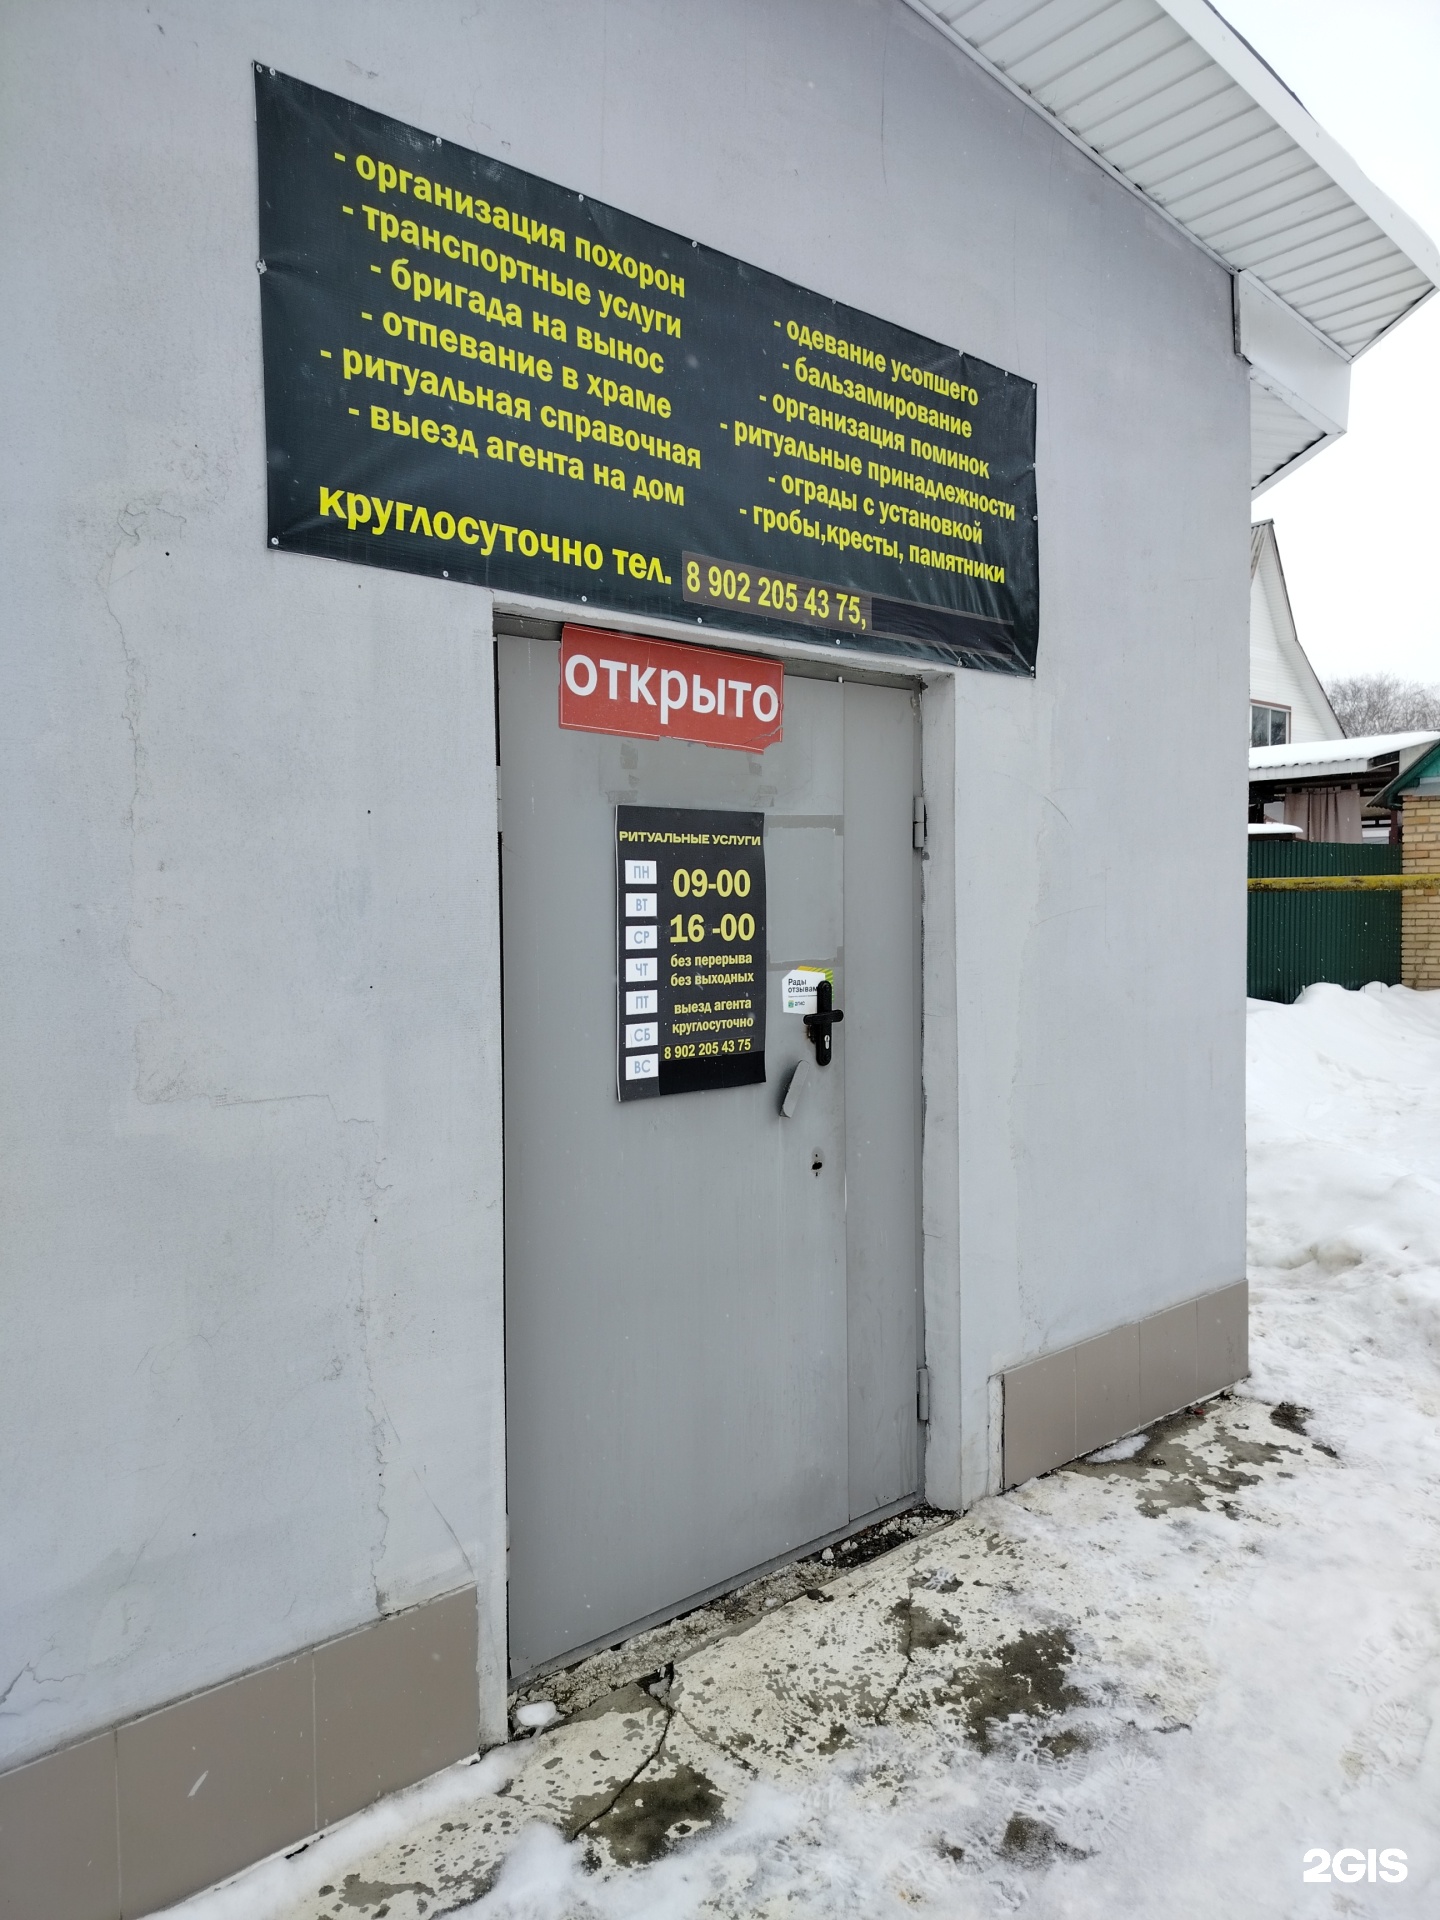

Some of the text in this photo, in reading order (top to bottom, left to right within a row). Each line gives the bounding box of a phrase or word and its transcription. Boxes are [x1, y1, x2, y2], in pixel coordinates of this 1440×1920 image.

[355, 154, 566, 253] организация
[575, 236, 685, 298] похорон
[361, 205, 592, 306] транспортные
[598, 289, 682, 339] услуги
[390, 257, 523, 328] бригада
[533, 311, 567, 343] на
[576, 325, 665, 375] вынос
[382, 311, 554, 383] отпевание
[562, 366, 580, 391] в
[586, 374, 672, 419] храме
[786, 319, 887, 373] одевание
[891, 358, 979, 407] усопшего
[343, 347, 532, 421] ритуальная
[540, 405, 702, 470] справочная
[795, 357, 973, 438] бальзамирование
[772, 393, 906, 452] организация
[911, 438, 990, 479] поминок
[370, 405, 480, 458] выезд
[487, 435, 585, 481] агента
[593, 464, 626, 491] на
[633, 475, 685, 507] дом
[734, 421, 863, 476] ритуальные
[868, 461, 1016, 521] принадлежности
[781, 474, 858, 512] ограды
[863, 496, 875, 516] с
[879, 498, 983, 545] установкой
[320, 486, 867, 630] круглосуточно тел. 8 902 205 43 75,
[909, 545, 1005, 584] памятники
[619, 831, 761, 846] РИТУАЛЬНЫЕ УСЛУГИ
[633, 865, 650, 879] ПН
[672, 868, 751, 898] 09-00
[635, 898, 648, 912] ВТ
[633, 930, 650, 945] СР
[635, 963, 648, 977] ЧТ
[670, 952, 753, 969] без перерыва
[670, 972, 755, 987] без выходных
[788, 978, 807, 986] Рады
[635, 995, 649, 1010] ПТ
[674, 999, 752, 1015] выезд агента
[634, 1028, 651, 1042] СБ
[672, 1017, 754, 1036] круглосуточно
[664, 1038, 751, 1060] 8 902 205 43 75
[634, 1059, 651, 1075] ВС
